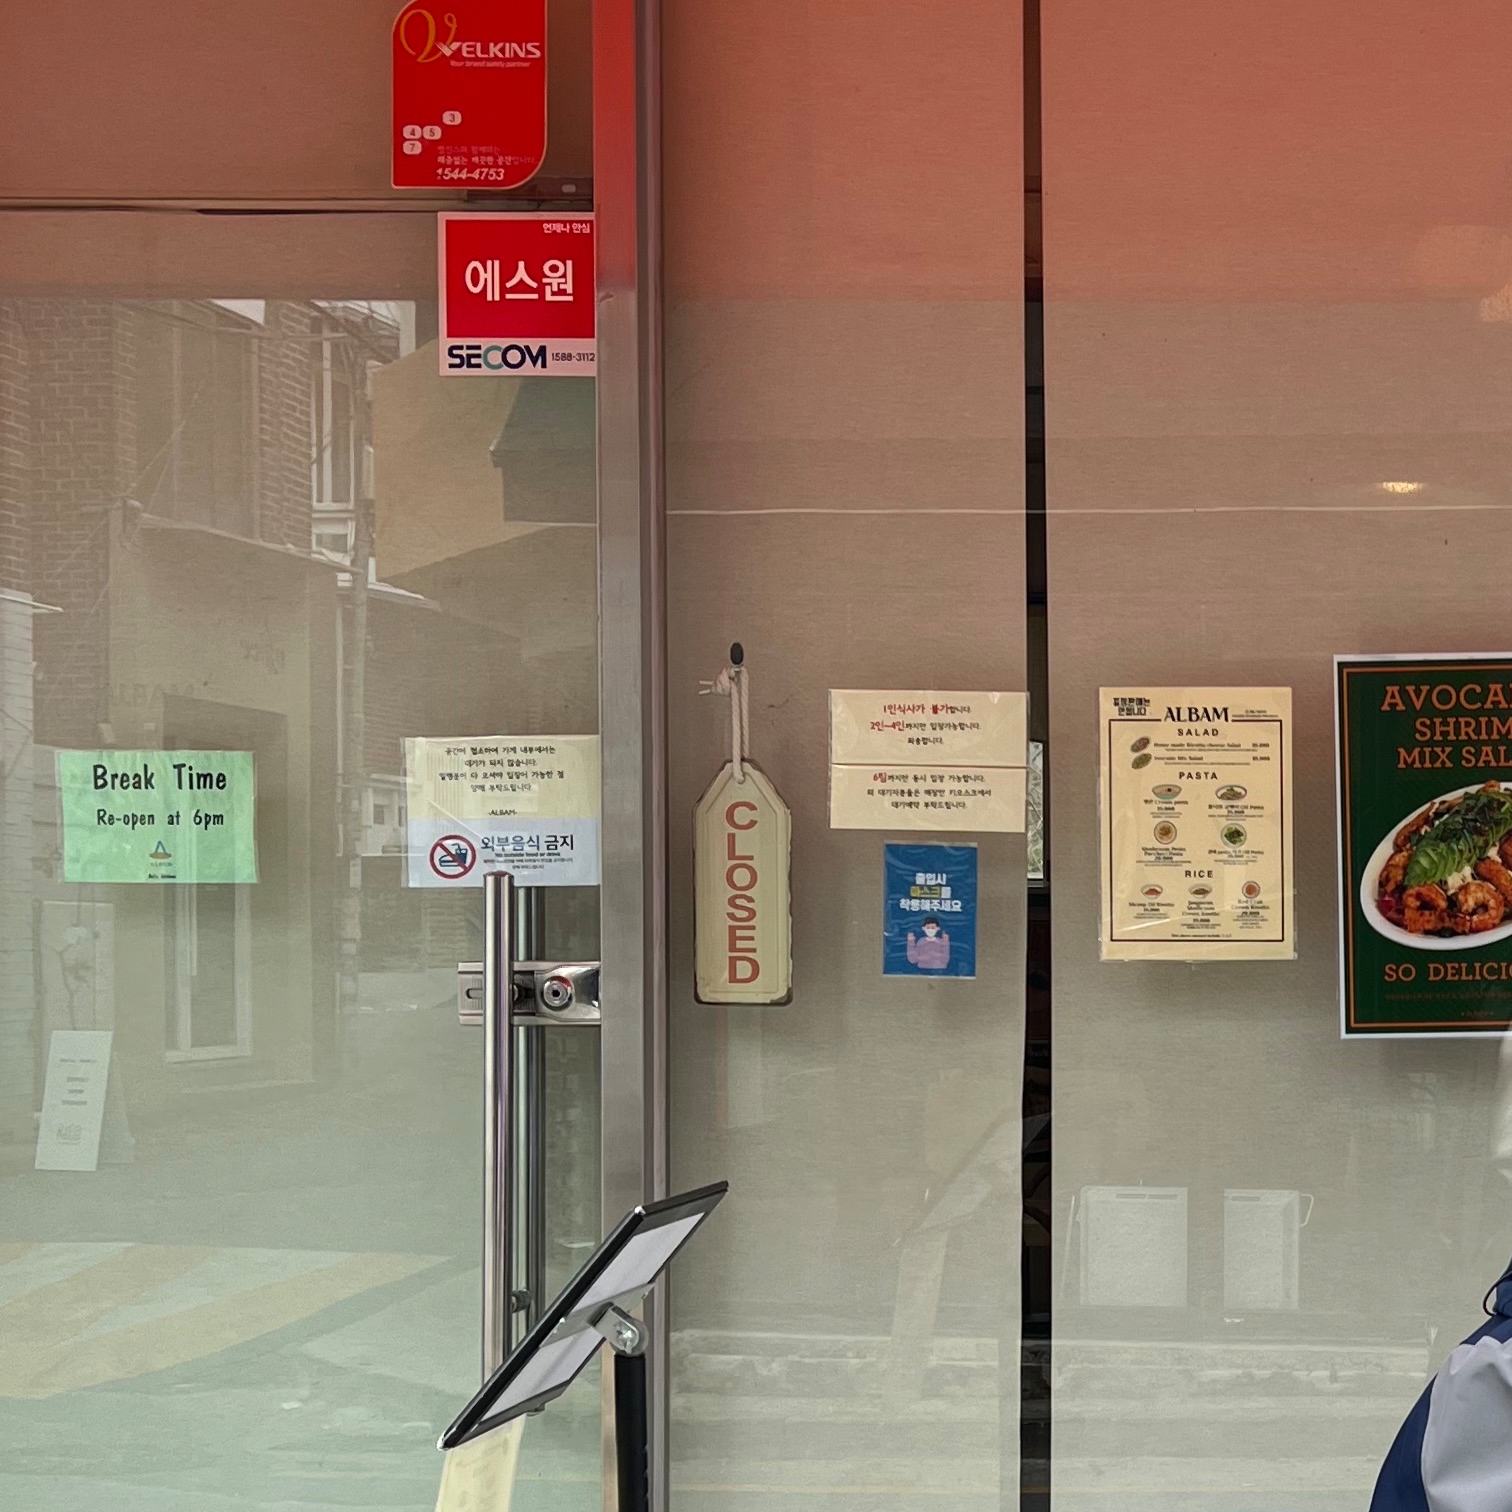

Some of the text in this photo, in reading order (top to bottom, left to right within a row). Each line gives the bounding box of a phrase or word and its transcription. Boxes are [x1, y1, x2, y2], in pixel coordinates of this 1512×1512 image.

[436, 167, 505, 180] 1544-4753
[543, 222, 590, 233] 언제나 안심
[465, 259, 574, 302] 에스원
[447, 344, 596, 370] SECOM 1588-3112
[1164, 706, 1230, 723] ALBAM
[1178, 728, 1219, 737] SALAD
[1398, 746, 1454, 769] MIX
[93, 763, 227, 790] Break Time
[1179, 772, 1218, 780] PASTA
[97, 809, 224, 830] Re-open at 6pm
[481, 834, 573, 852] 외부음식 금지
[1185, 870, 1213, 878] RICE
[725, 801, 760, 984] CLOSED
[1384, 963, 1416, 982] SO
